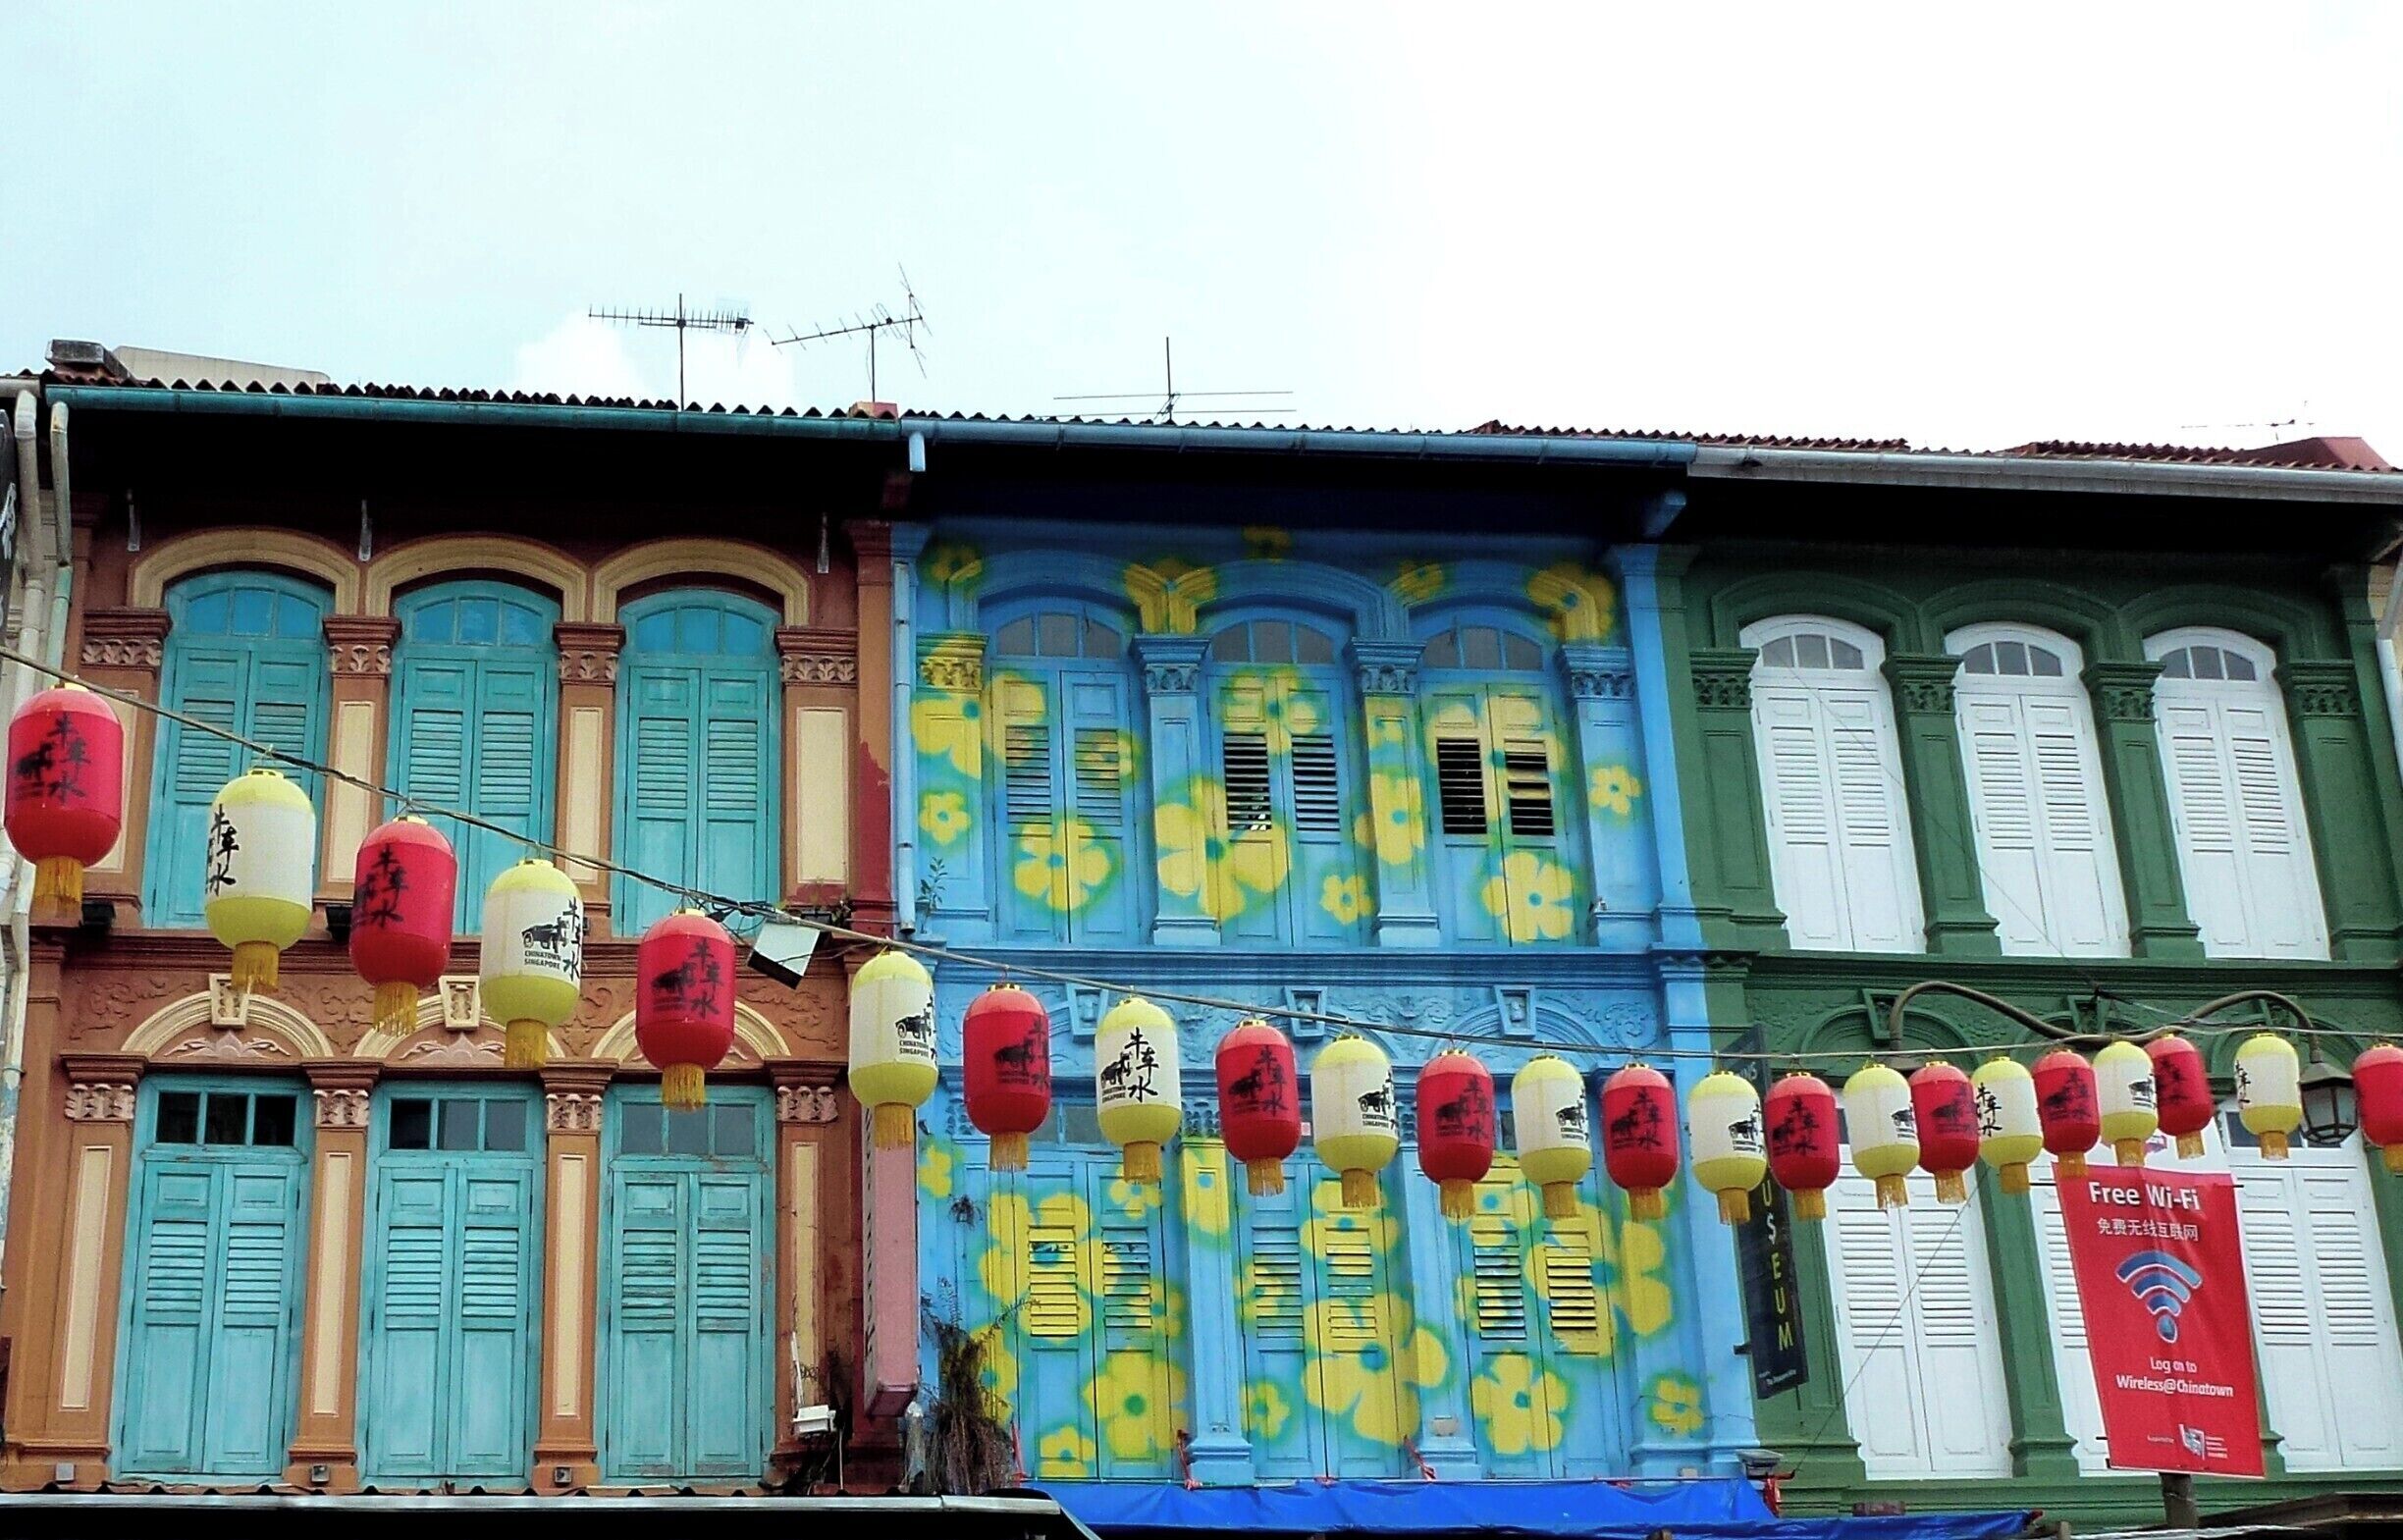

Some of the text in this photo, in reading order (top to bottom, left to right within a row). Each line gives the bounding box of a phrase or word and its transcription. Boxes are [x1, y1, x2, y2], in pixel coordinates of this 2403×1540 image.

[524, 949, 561, 962] CHINATOWN
[524, 958, 561, 970] SINGAPORE
[2088, 1181, 2200, 1210] Free Wi-Fi
[2097, 1217, 2199, 1242] 免费无线互联网
[2150, 1356, 2197, 1373] Log on to
[2115, 1374, 2233, 1397] Wireless@Chinatown
